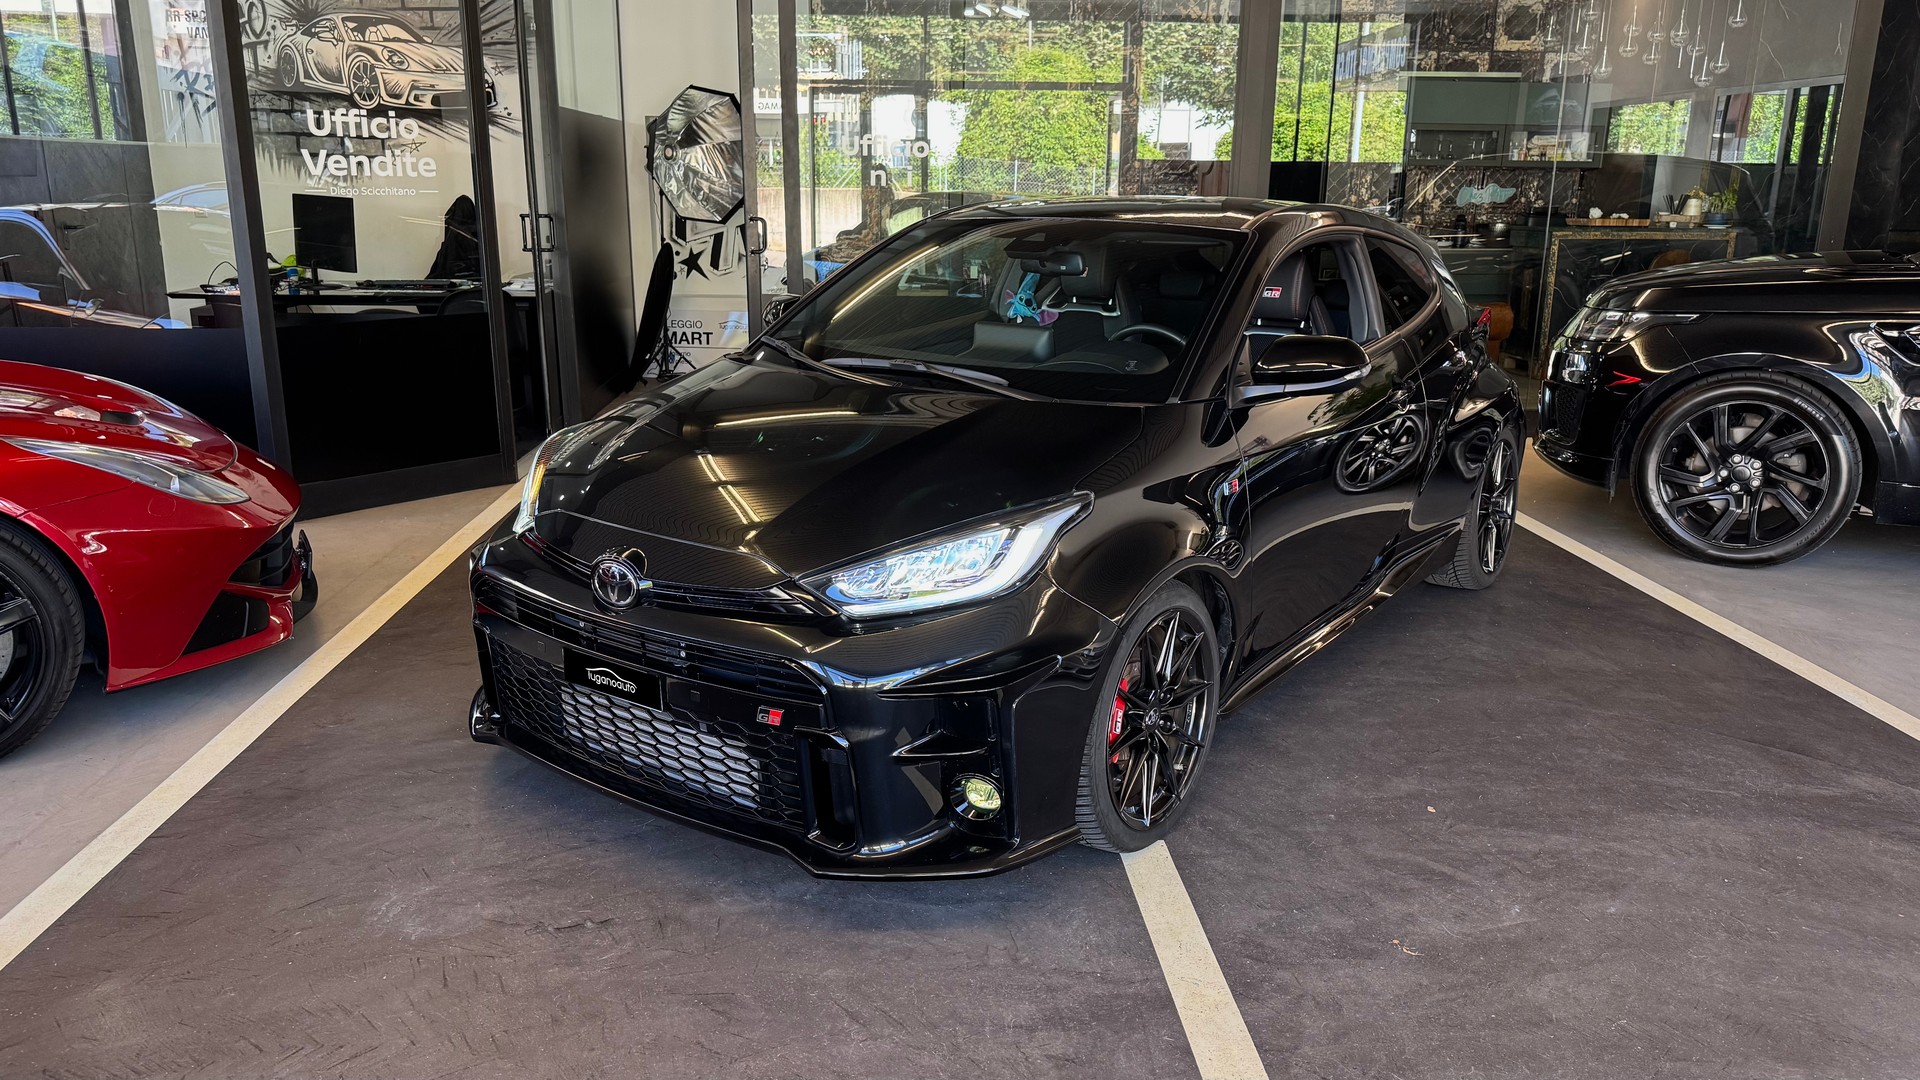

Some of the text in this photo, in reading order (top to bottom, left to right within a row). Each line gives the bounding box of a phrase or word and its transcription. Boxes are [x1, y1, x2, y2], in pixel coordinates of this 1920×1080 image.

[306, 108, 419, 140] Ufficio
[300, 149, 437, 177] Vendite
[330, 187, 416, 197] Diego Scicchitano
[664, 331, 713, 346] MART
[587, 669, 636, 694] luganoauto
